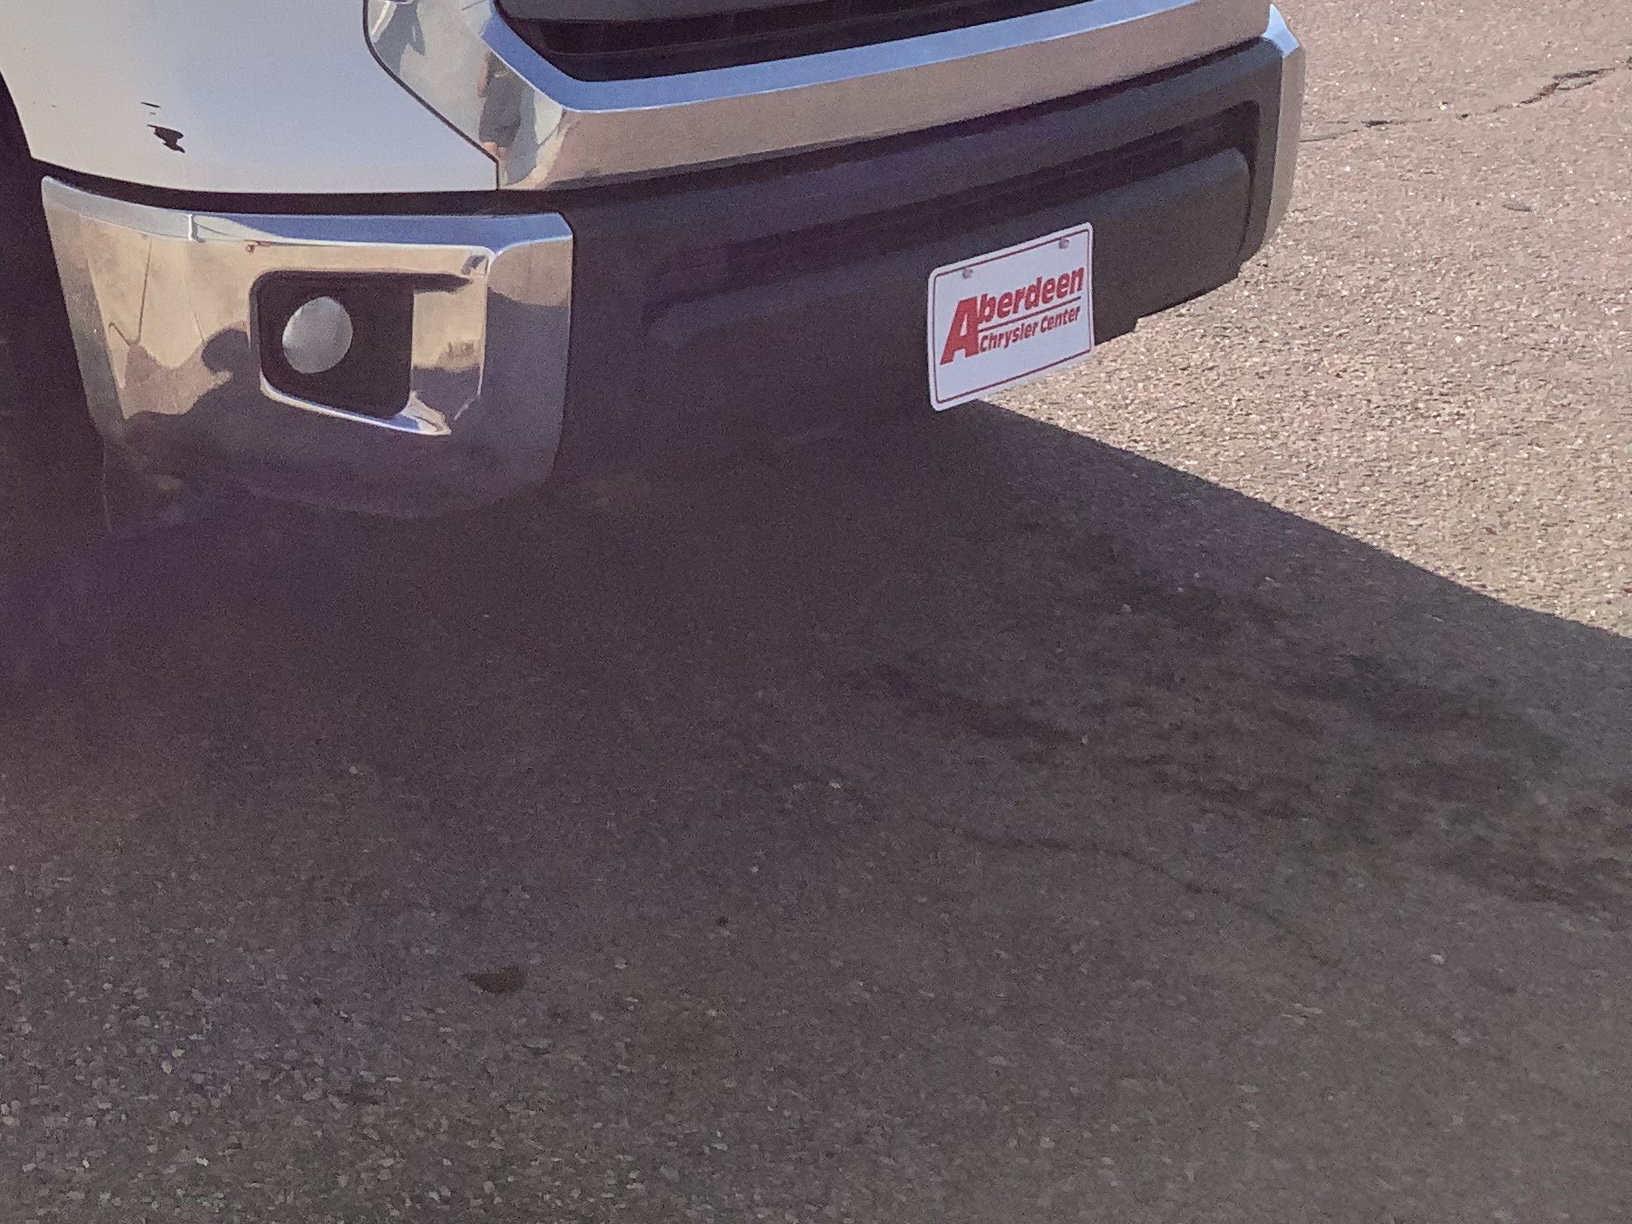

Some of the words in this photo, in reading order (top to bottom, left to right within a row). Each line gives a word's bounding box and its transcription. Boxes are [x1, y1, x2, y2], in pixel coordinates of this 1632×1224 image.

[939, 266, 1085, 366] Aberdeen
[979, 322, 1039, 353] Chrysler
[1040, 305, 1081, 333] Center
